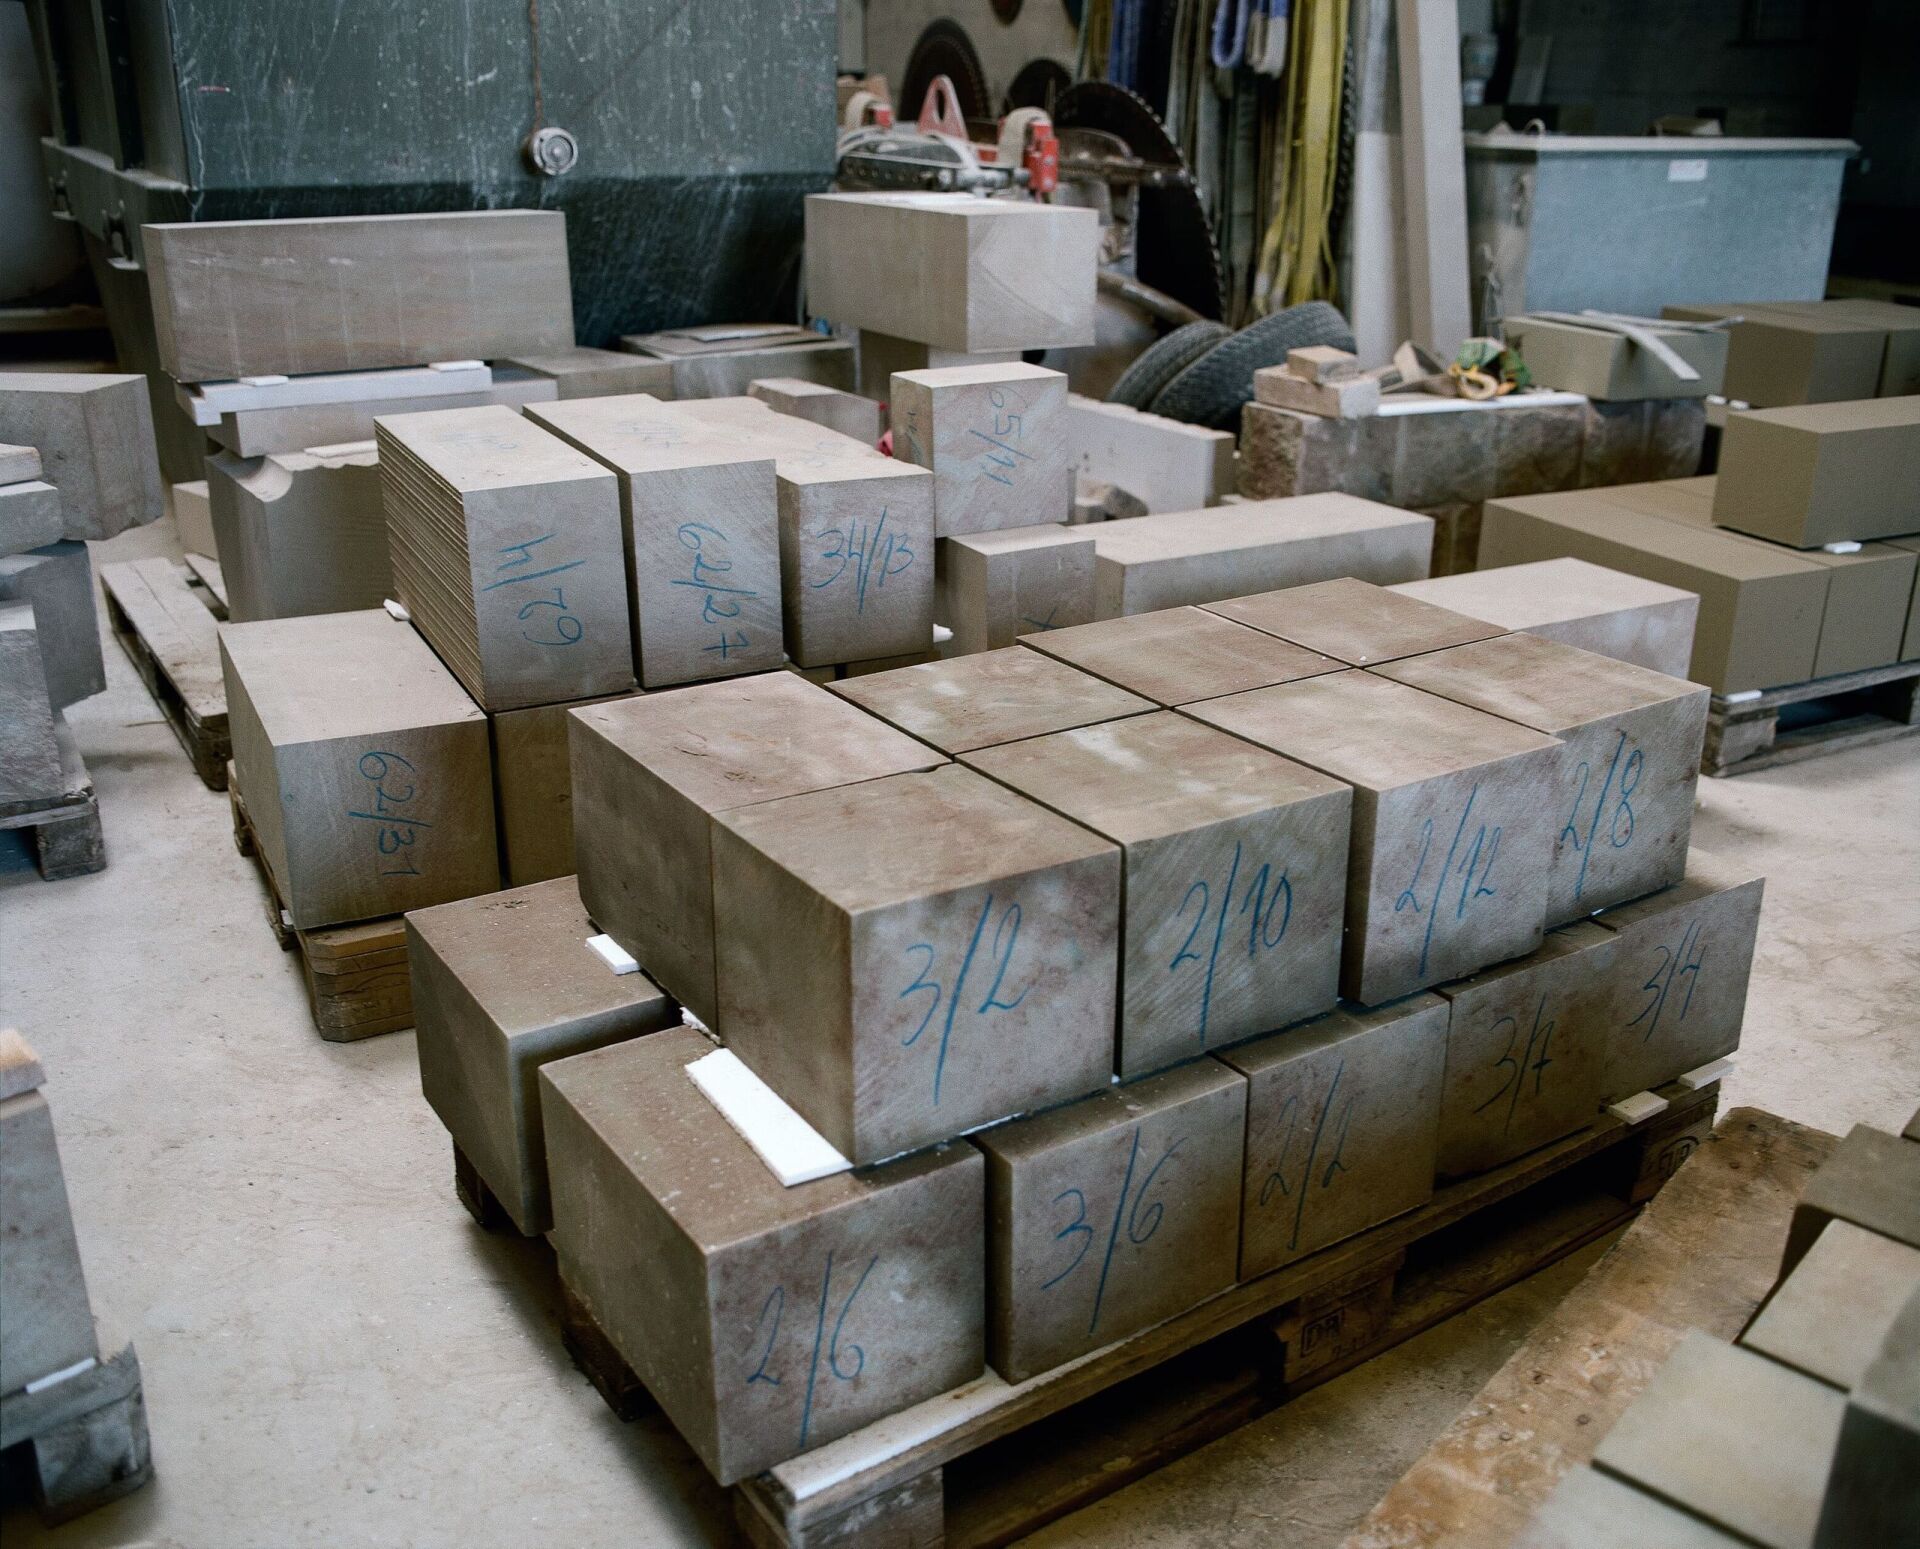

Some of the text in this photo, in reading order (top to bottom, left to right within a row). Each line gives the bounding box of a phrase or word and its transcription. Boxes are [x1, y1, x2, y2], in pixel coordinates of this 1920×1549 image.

[670, 522, 757, 660] 62/27
[811, 505, 915, 615] 34/13
[346, 751, 433, 876] 62/31
[1394, 783, 1501, 977] 2/12
[1560, 730, 1644, 900] 2/8
[900, 893, 1031, 1106] 3/2
[1169, 841, 1294, 1046] 2/10
[1627, 919, 1708, 1043] 3/4
[1040, 1126, 1188, 1335] 3/6
[1259, 1059, 1354, 1251] 2/2
[746, 1249, 880, 1449] 2/6
